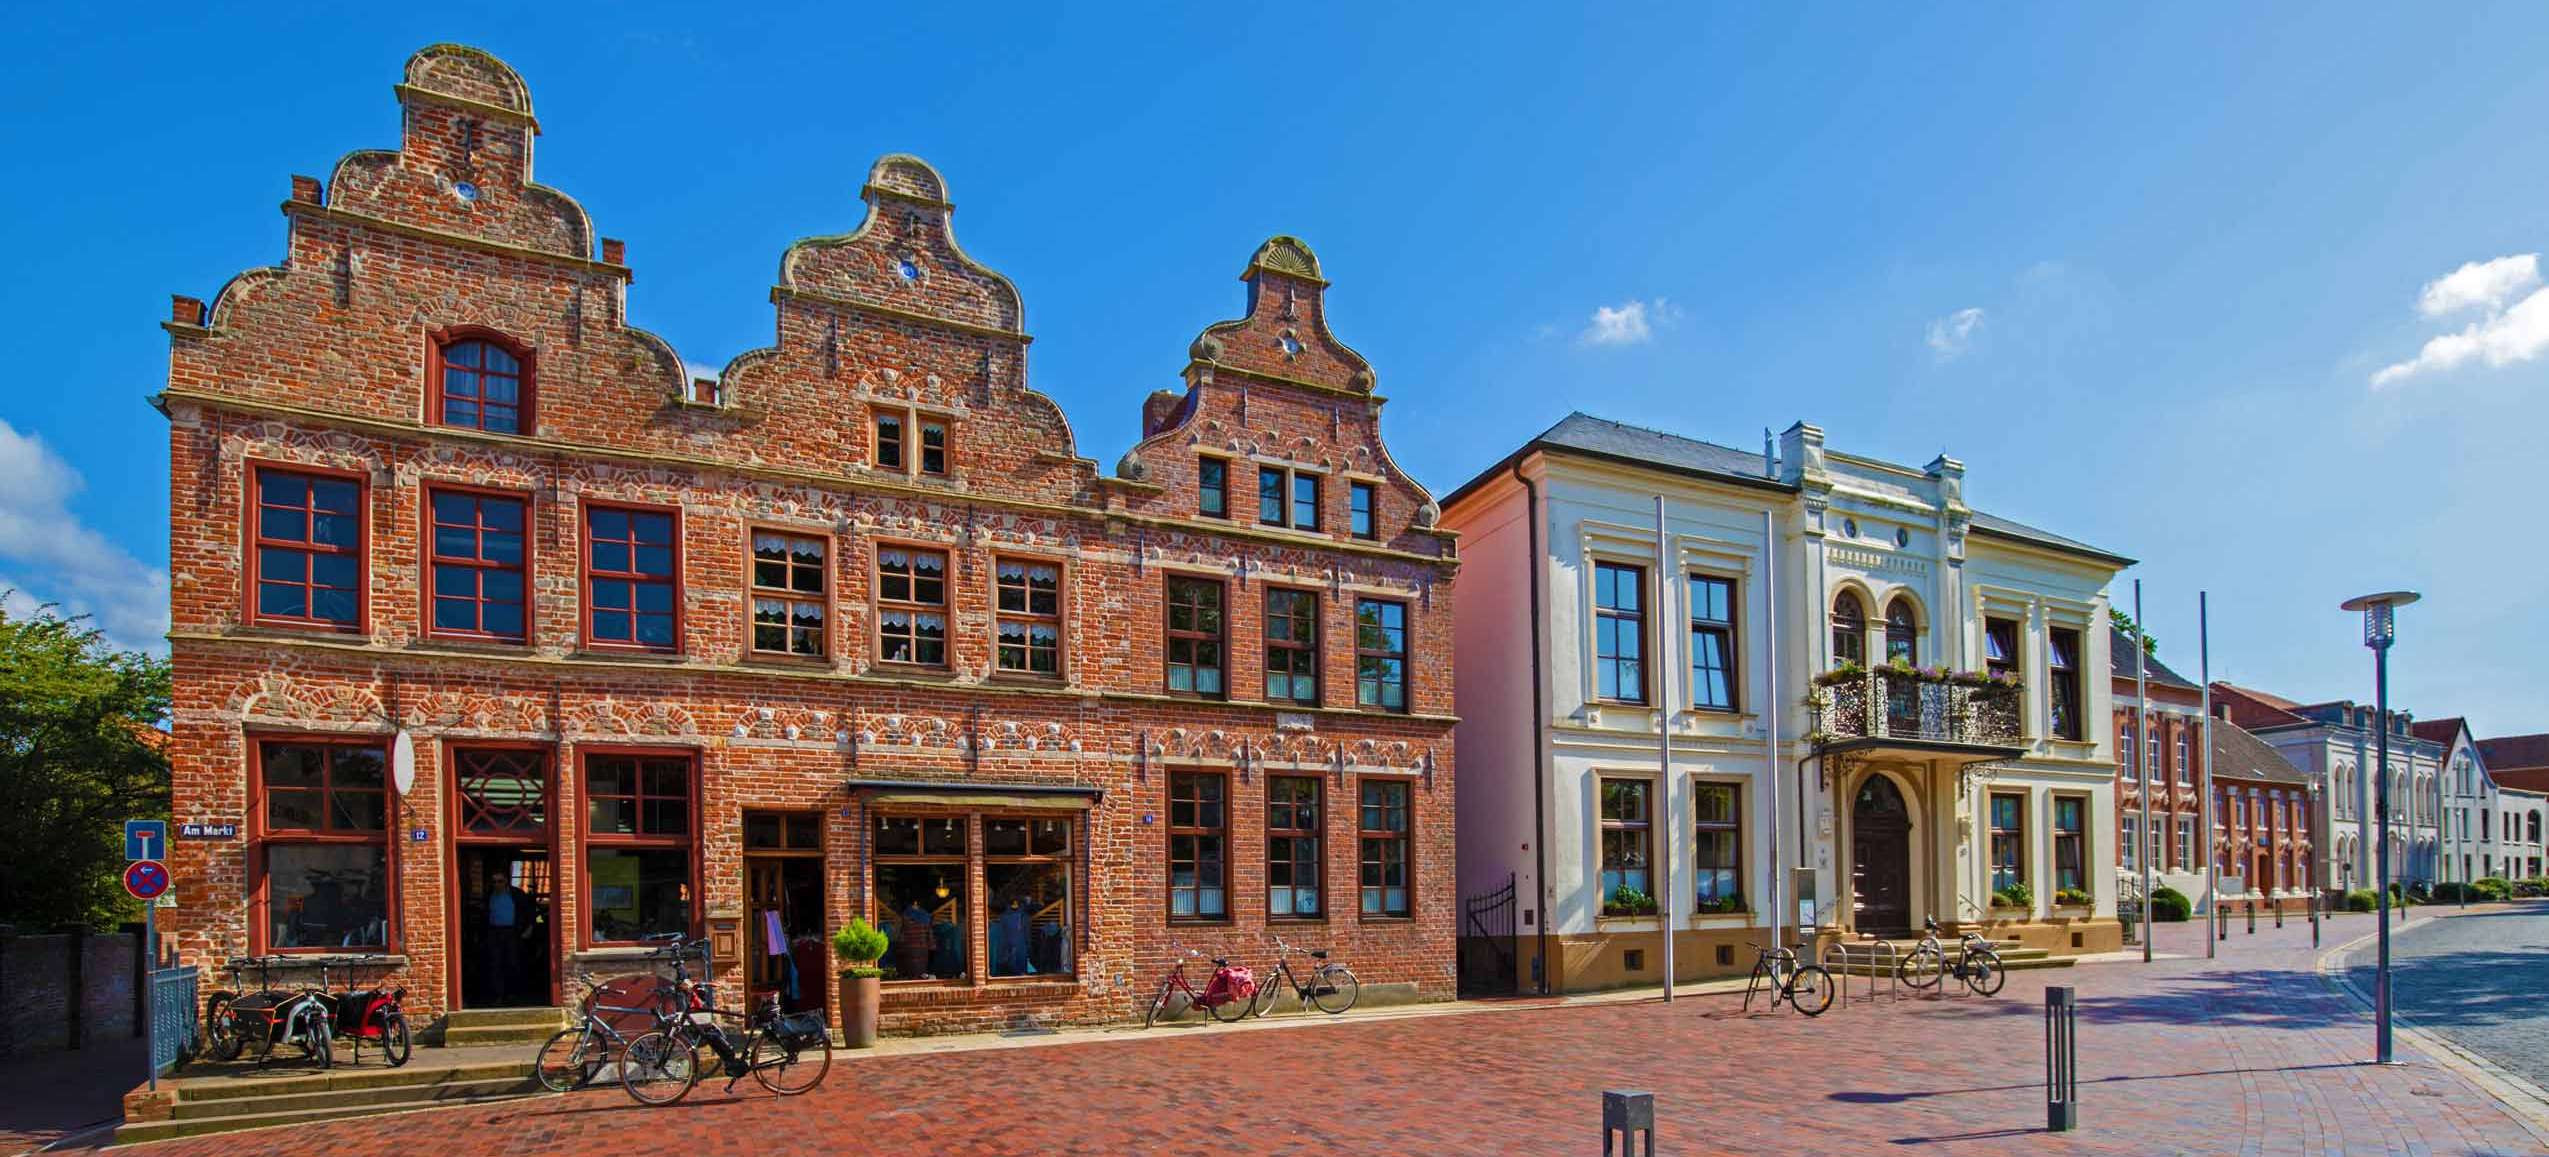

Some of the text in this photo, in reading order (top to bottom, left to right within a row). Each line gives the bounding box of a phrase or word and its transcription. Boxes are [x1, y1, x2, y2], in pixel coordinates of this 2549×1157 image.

[183, 825, 233, 836] Am Markt
[415, 831, 425, 840] 12
